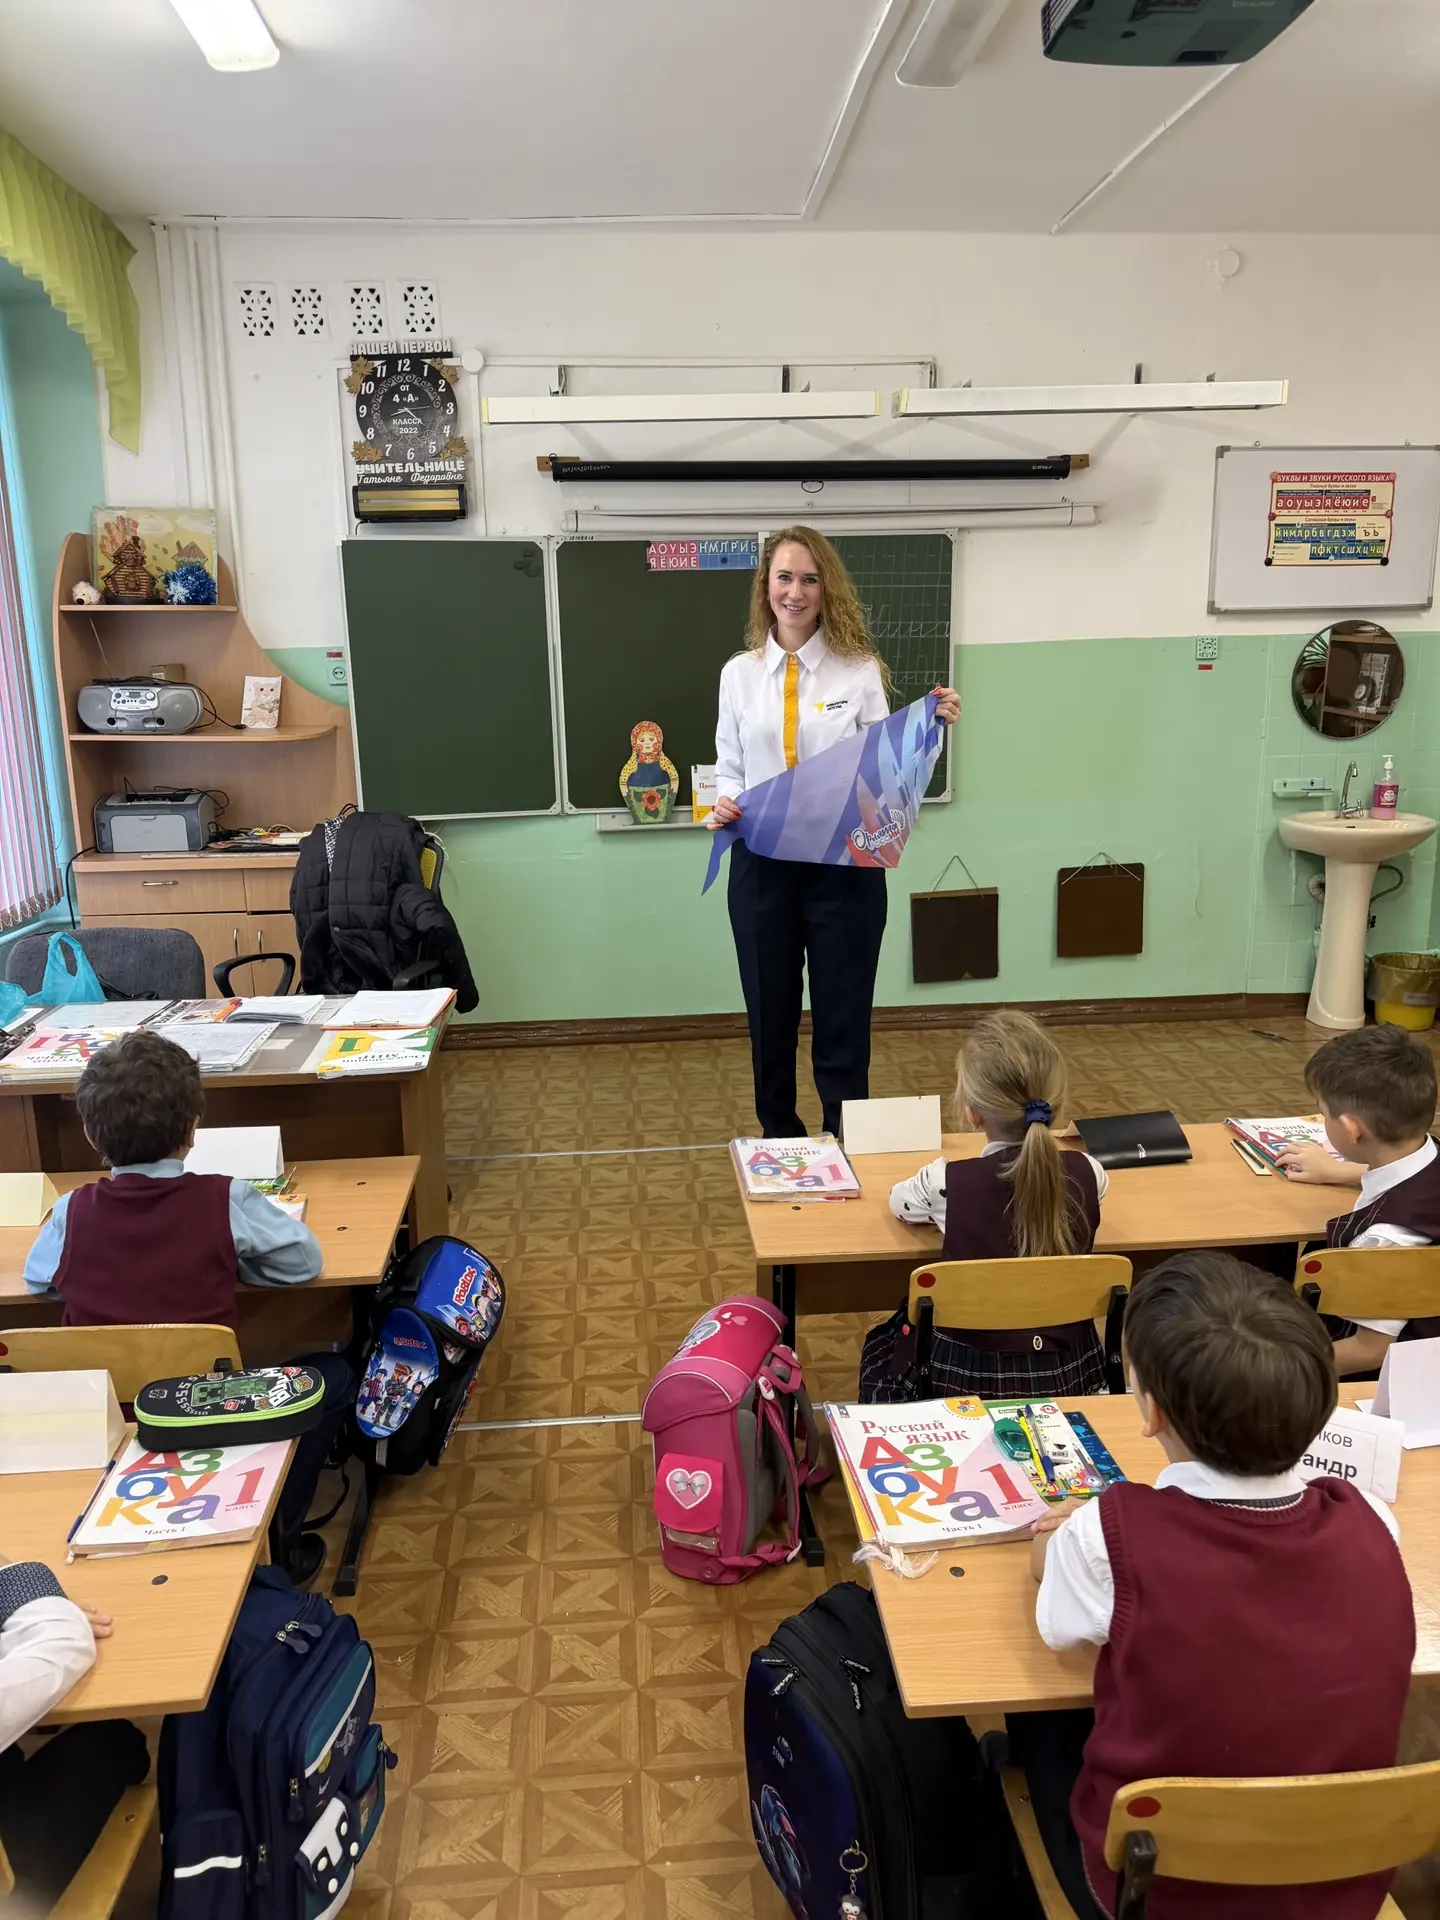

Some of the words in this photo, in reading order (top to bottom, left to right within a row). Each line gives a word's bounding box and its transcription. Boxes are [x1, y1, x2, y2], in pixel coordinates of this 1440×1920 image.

[350, 341, 397, 355] НАШЕЙ
[401, 339, 452, 353] ПЕРВОЙ
[377, 365, 387, 377] 11
[397, 359, 410, 372] 12
[423, 364, 428, 377] 1
[361, 381, 375, 395] 10
[438, 380, 446, 392] 2
[359, 405, 367, 418] 9
[446, 402, 454, 415] 3
[366, 427, 374, 440] 8
[443, 425, 451, 437] 4
[385, 444, 392, 457] 7
[407, 448, 415, 460] 6
[429, 442, 436, 454] 5
[356, 460, 465, 474] УЧИТЕЛЬНИЦЕ
[358, 475, 402, 484] Татьяне
[1333, 474, 1366, 482] РУССКОГО
[859, 1420, 945, 1436] Русский
[1298, 1453, 1358, 1480] андр
[1003, 1502, 1034, 1511] класс
[144, 1527, 177, 1536] Часть
[941, 1525, 975, 1534] Часть
